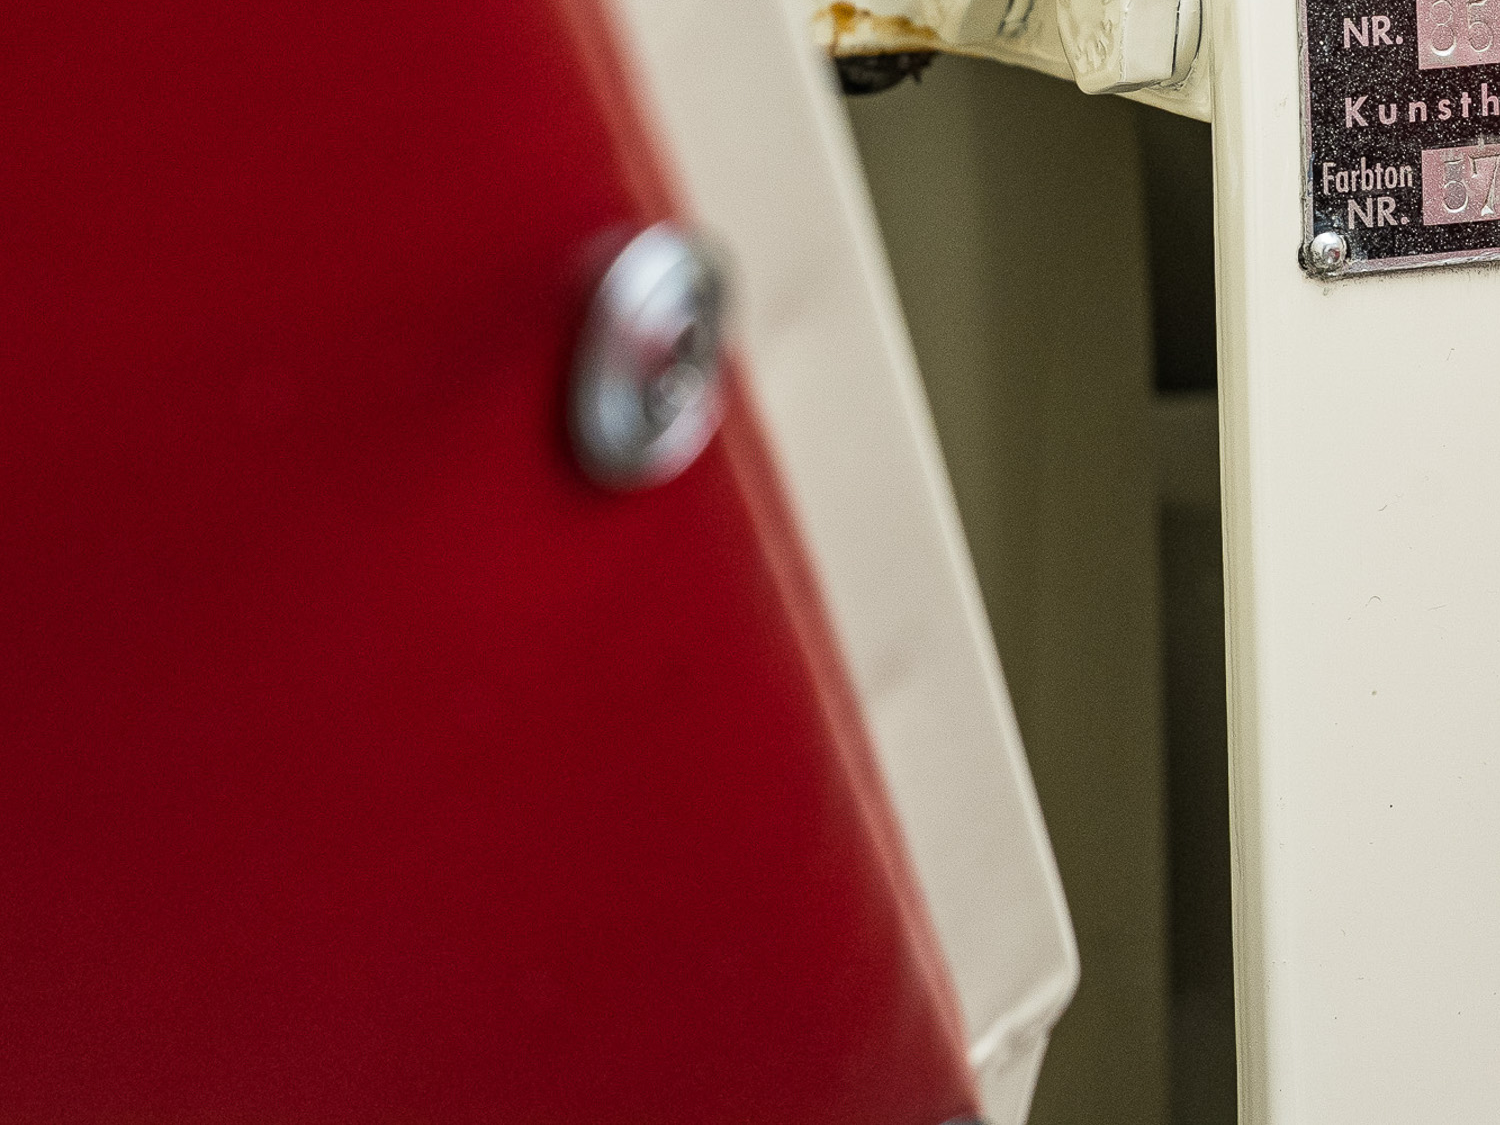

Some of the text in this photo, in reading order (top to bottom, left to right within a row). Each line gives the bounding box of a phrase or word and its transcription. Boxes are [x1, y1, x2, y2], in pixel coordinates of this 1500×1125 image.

[1343, 16, 1403, 48] NR.
[1322, 157, 1414, 196] Farbton
[1348, 196, 1410, 230] NR.
